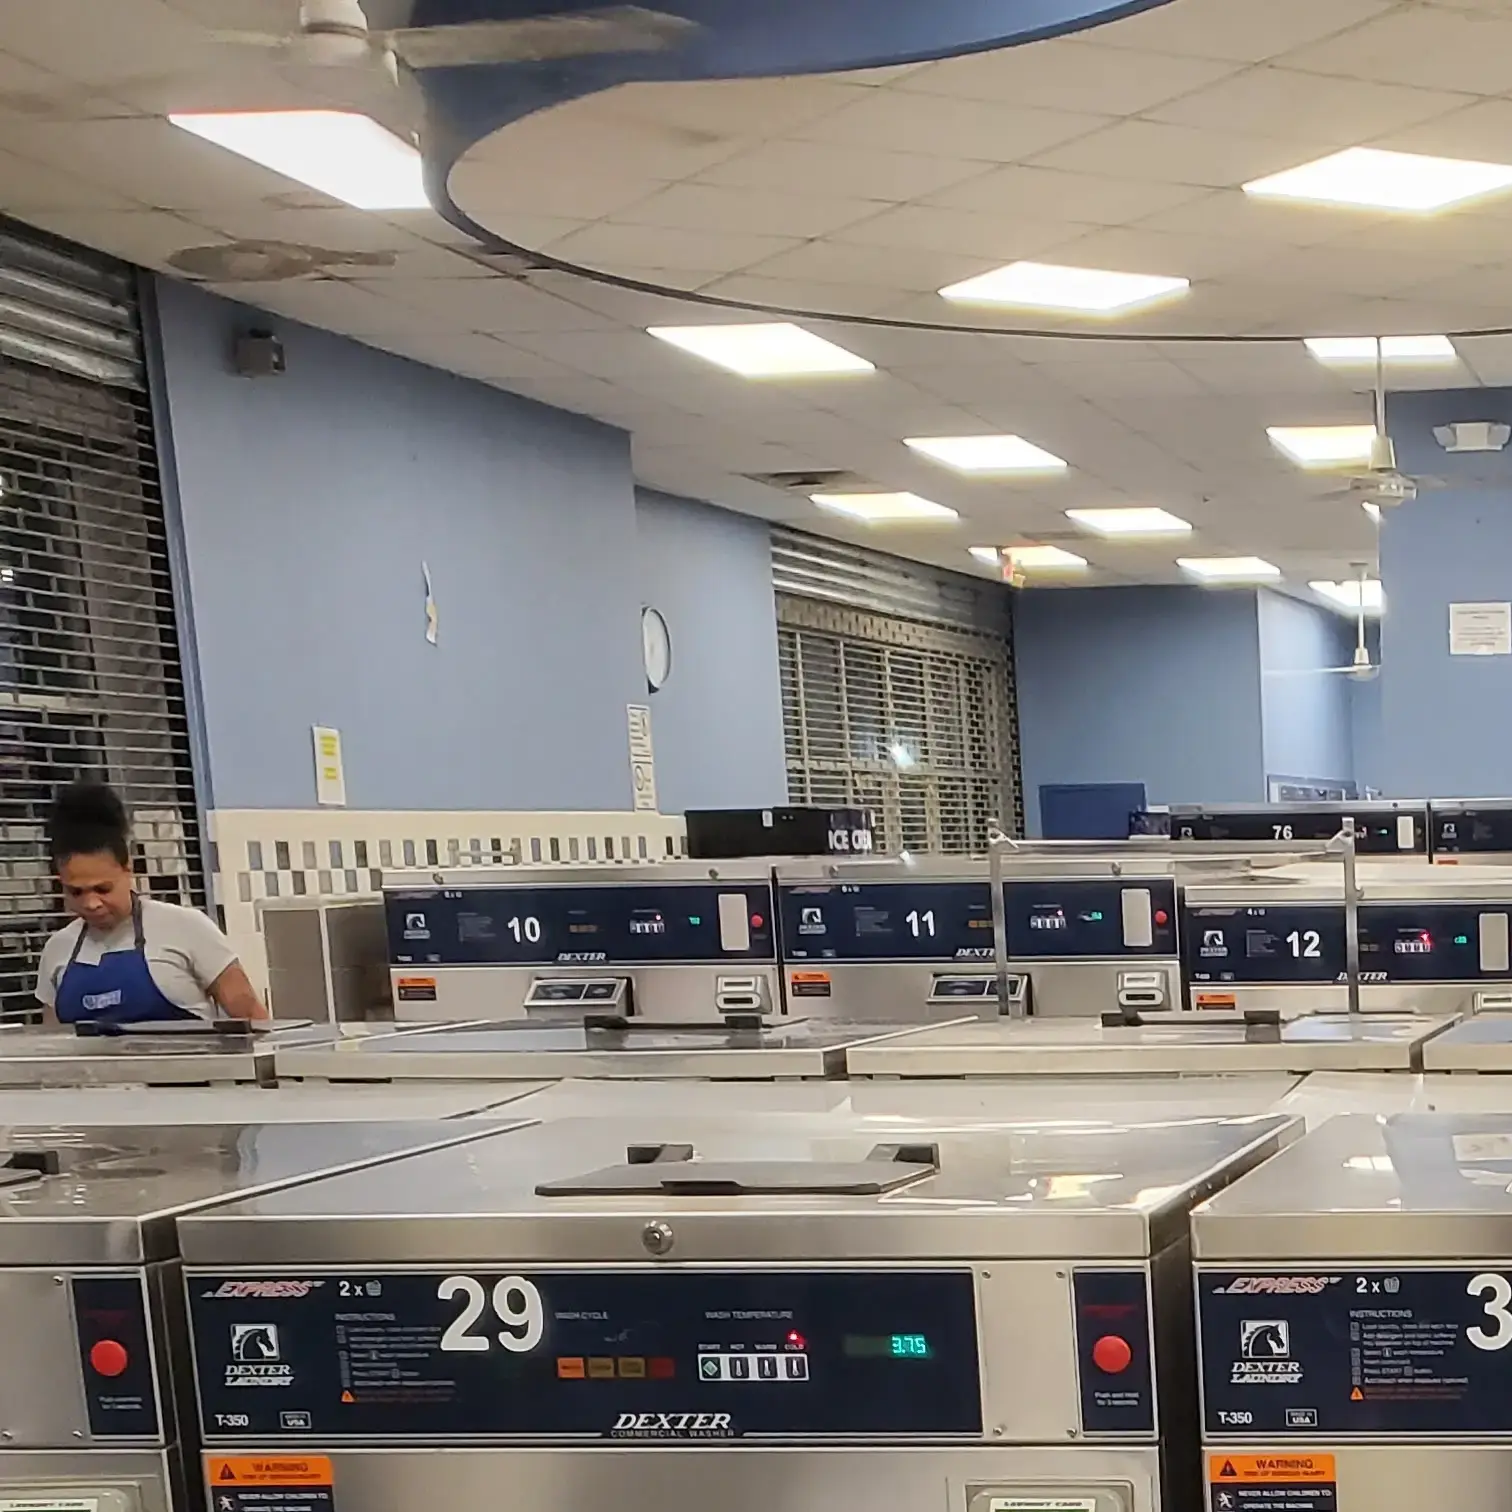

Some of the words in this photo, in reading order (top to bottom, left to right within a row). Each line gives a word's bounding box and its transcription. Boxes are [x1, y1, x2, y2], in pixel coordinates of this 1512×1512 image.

[828, 830, 850, 850] ICE
[1272, 824, 1293, 840] 76
[507, 916, 541, 943] 10
[905, 910, 935, 937] 11
[1286, 930, 1321, 958] 12
[557, 952, 606, 961] DEXTER
[214, 1280, 314, 1297] EXPRESS
[339, 1281, 350, 1296] 2
[354, 1285, 363, 1296] x
[1222, 1277, 1329, 1294] EXPRESS
[1356, 1278, 1367, 1293] 2
[1372, 1282, 1380, 1293] x
[437, 1275, 544, 1352] 29
[1350, 1310, 1412, 1318] INSTRUCTIONS
[892, 1336, 926, 1354] 3.75
[225, 1365, 290, 1376] DEXTER
[1231, 1362, 1301, 1372] DEXTER
[215, 1414, 249, 1426] T-350
[612, 1413, 731, 1429] DEXTER
[1218, 1412, 1252, 1424] T-350
[1256, 1459, 1313, 1469] WARNING
